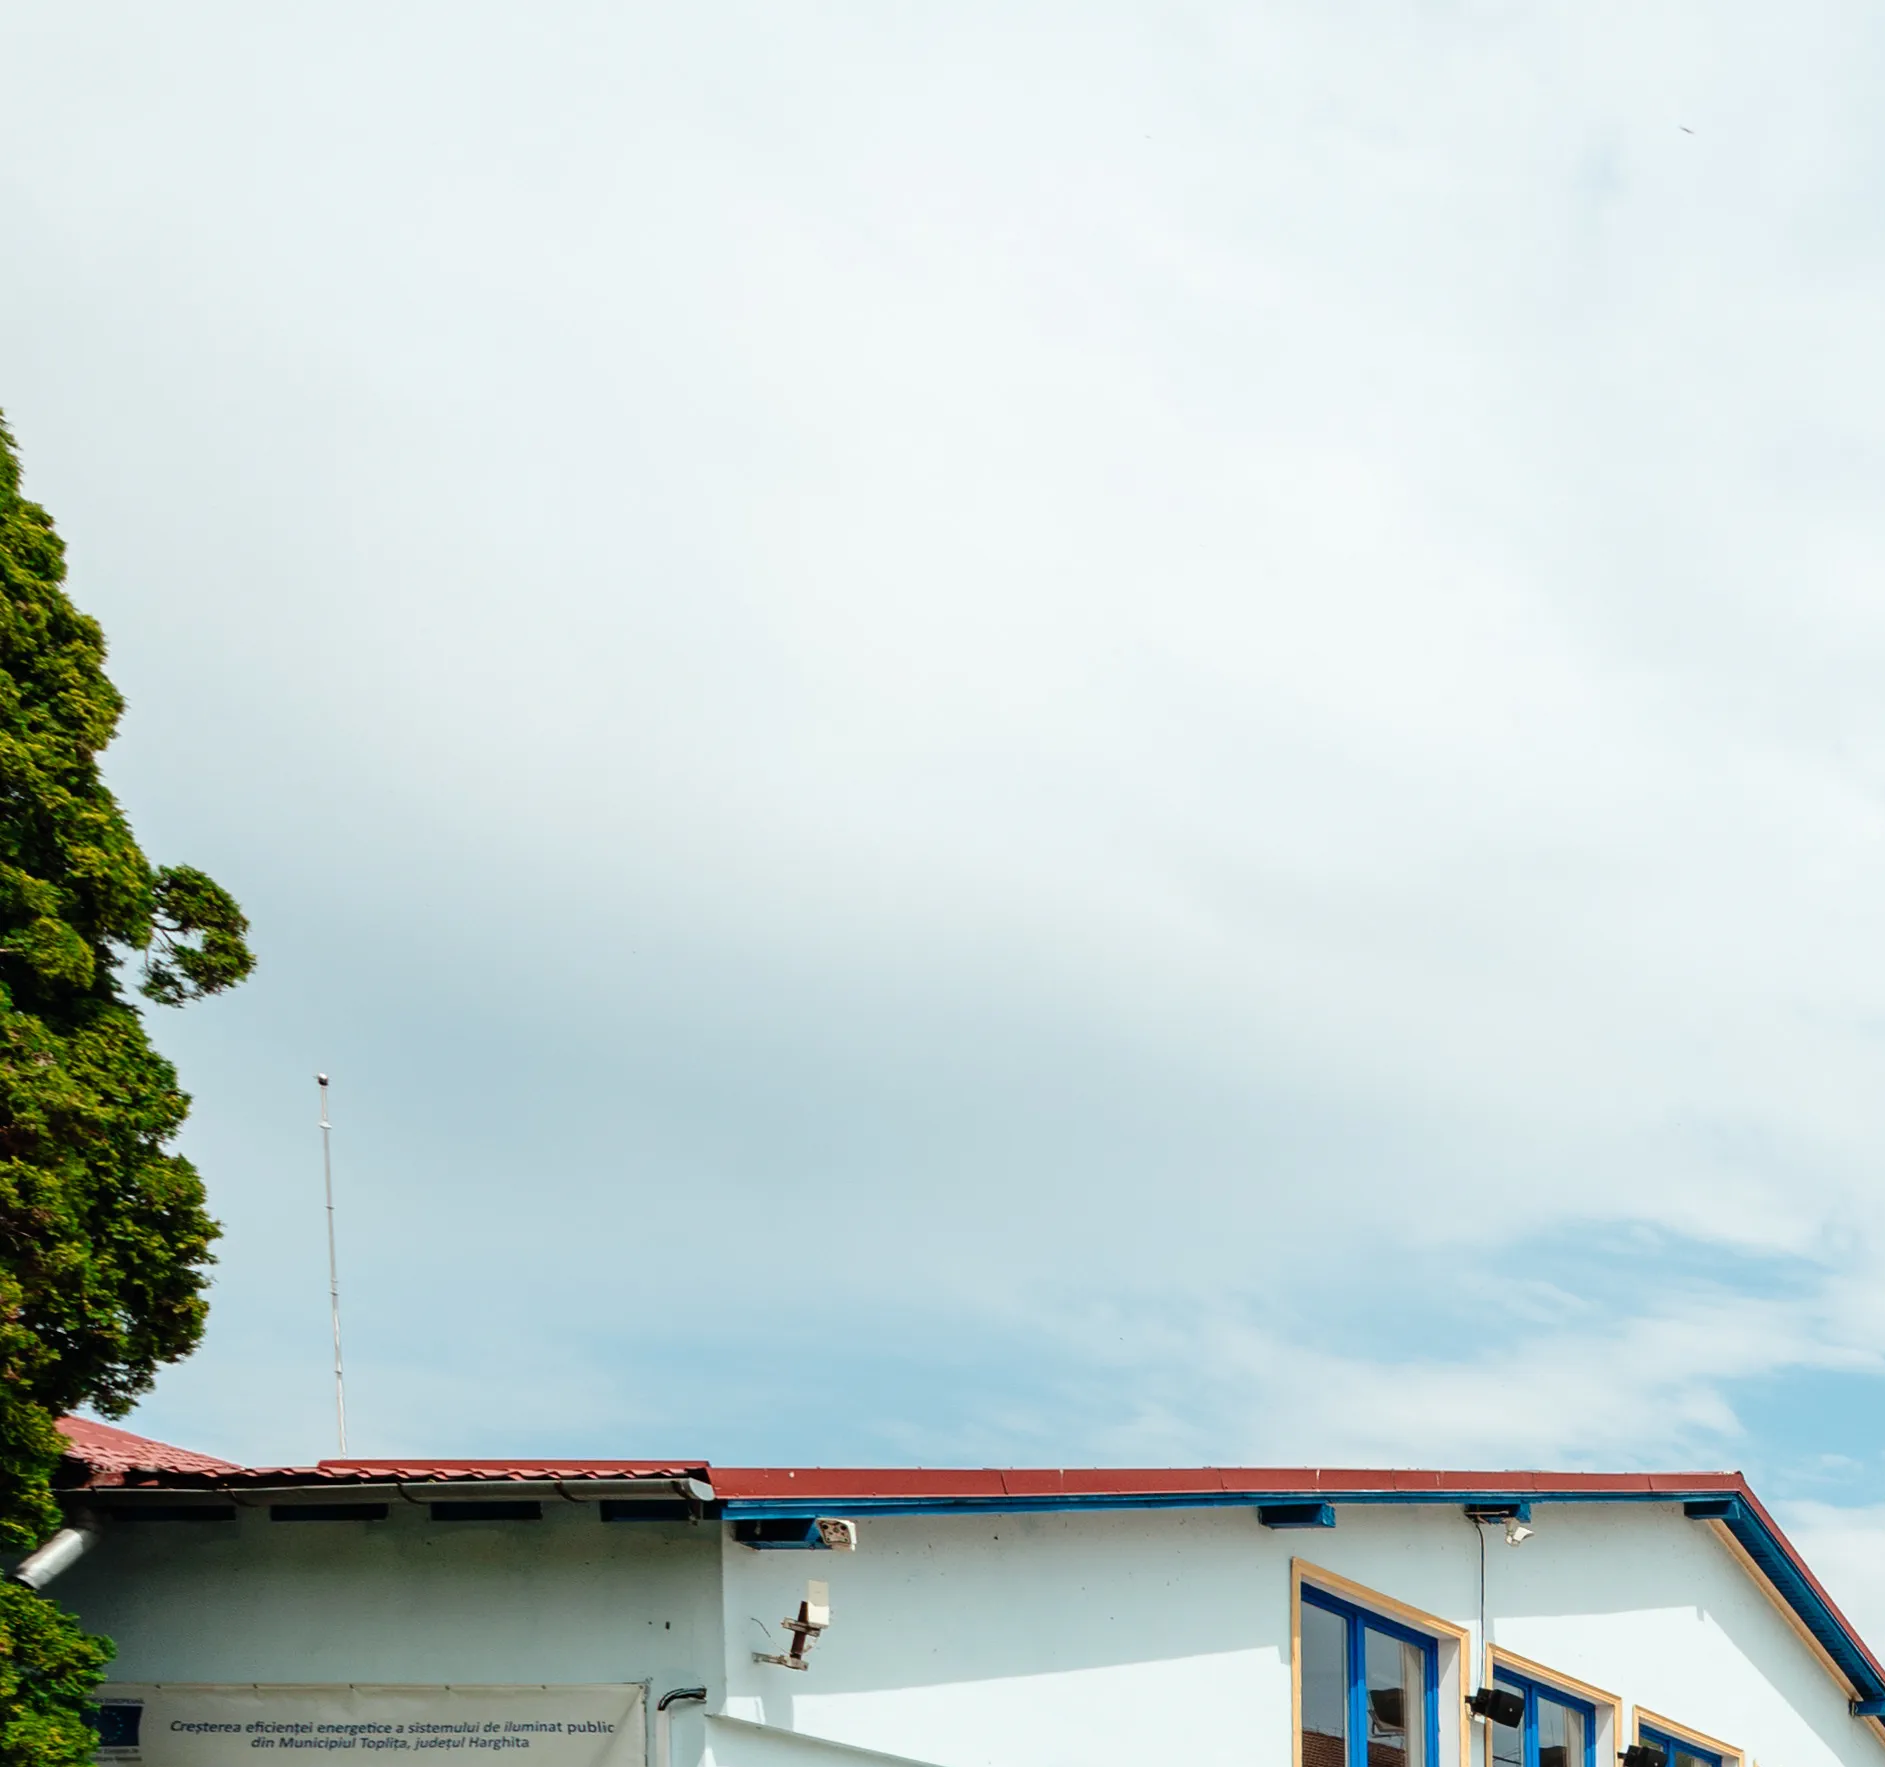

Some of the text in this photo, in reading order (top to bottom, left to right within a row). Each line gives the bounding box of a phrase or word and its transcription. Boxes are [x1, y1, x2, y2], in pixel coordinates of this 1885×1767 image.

[170, 1720, 616, 1736] Creșterea eficienței energetice a sistemului de iluminat public
[251, 1737, 275, 1749] din
[279, 1737, 356, 1751] Municipiul
[414, 1737, 465, 1750] județul
[469, 1737, 530, 1750] Harghita
